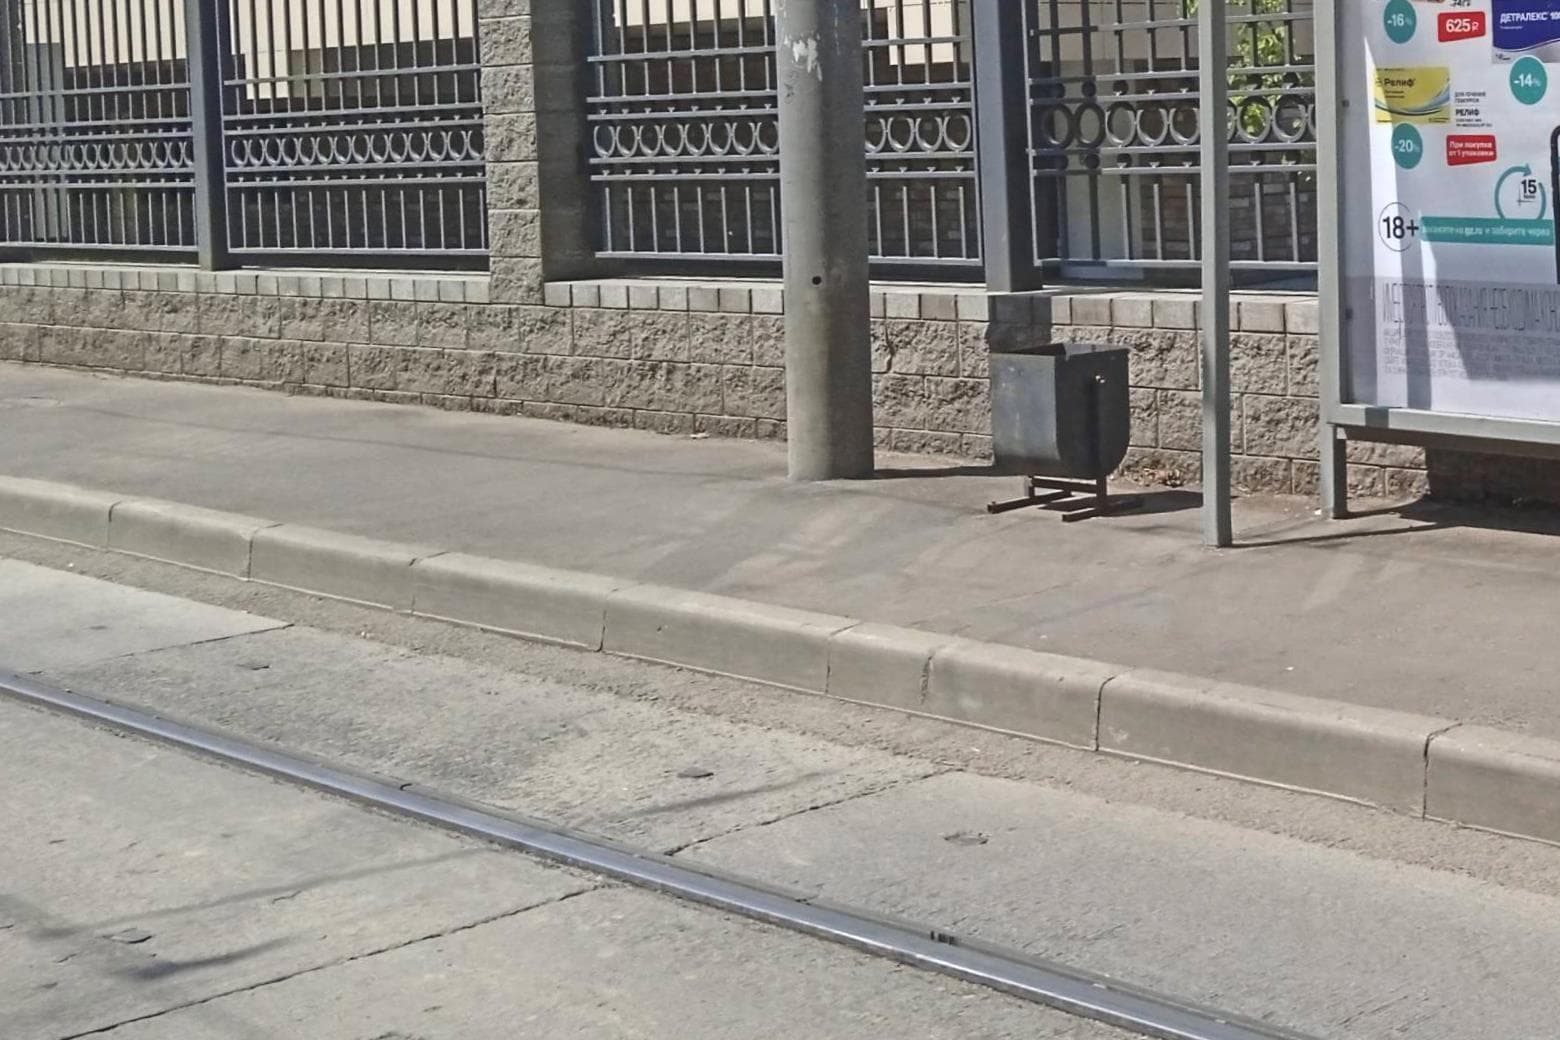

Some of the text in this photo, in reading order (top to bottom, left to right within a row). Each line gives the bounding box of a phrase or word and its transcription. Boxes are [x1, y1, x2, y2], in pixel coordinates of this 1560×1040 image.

[1500, 11, 1548, 24] ДЕТРАЛЕКС
[1384, 77, 1414, 87] Релиф
[1455, 108, 1480, 117] РЕЛИФ
[1521, 179, 1537, 194] 15
[1382, 215, 1419, 239] 18+
